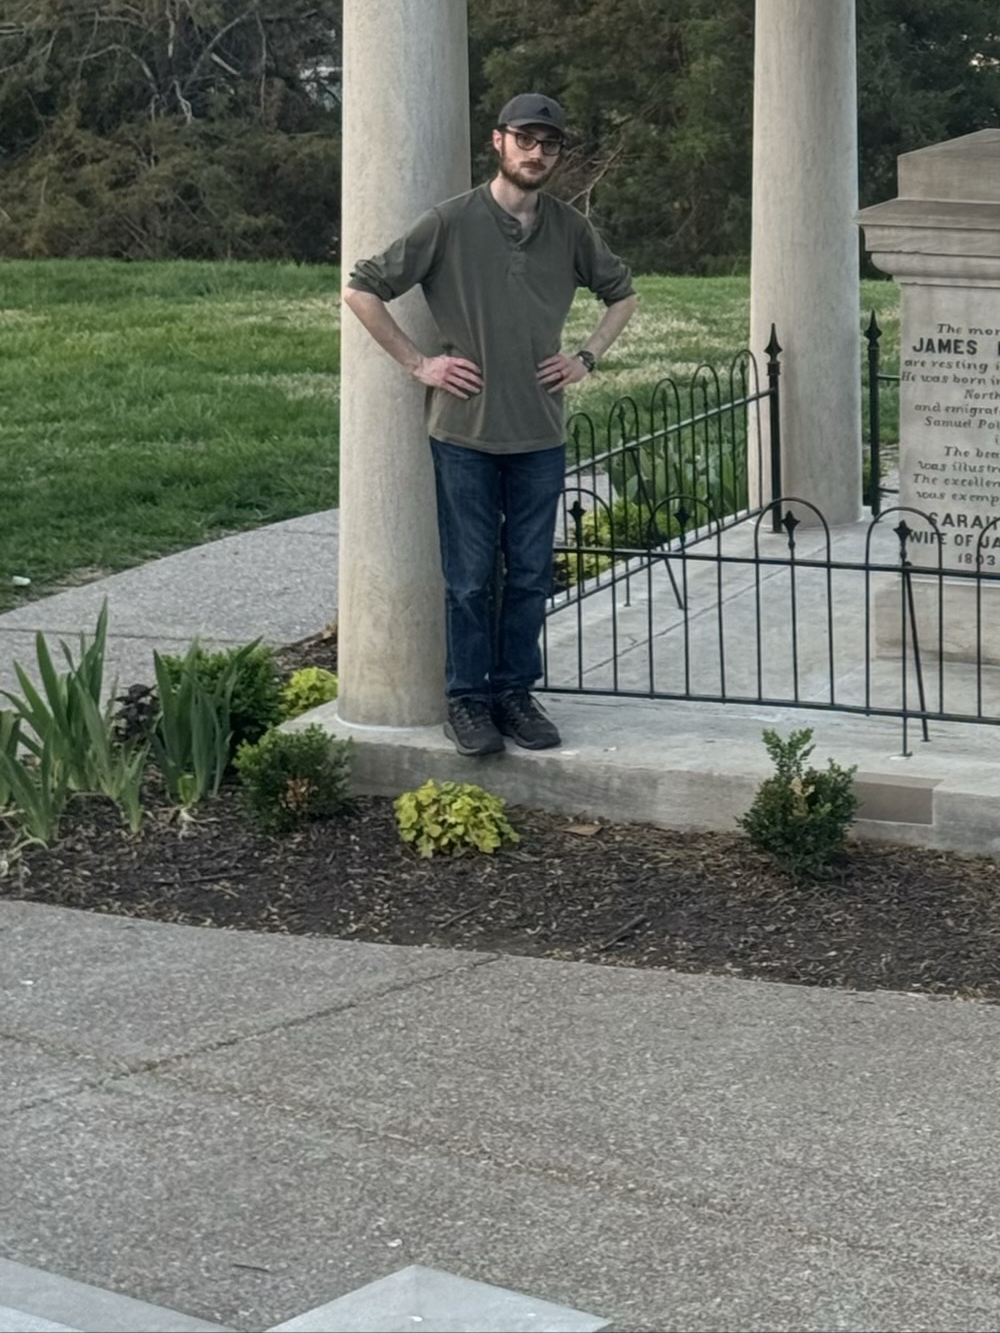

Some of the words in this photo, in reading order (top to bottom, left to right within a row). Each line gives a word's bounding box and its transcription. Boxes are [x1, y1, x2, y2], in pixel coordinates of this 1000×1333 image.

[937, 323, 962, 334] The
[912, 337, 978, 355] JAMES
[904, 359, 927, 368] are
[931, 360, 988, 374] resting
[901, 371, 916, 382] He
[920, 374, 949, 384] was
[952, 374, 986, 385] born
[914, 402, 941, 412] and
[925, 416, 971, 428] Samuel
[944, 446, 970, 457] The
[918, 460, 946, 471] was
[913, 473, 939, 485] The
[916, 491, 946, 500] was
[954, 534, 974, 546] OF
